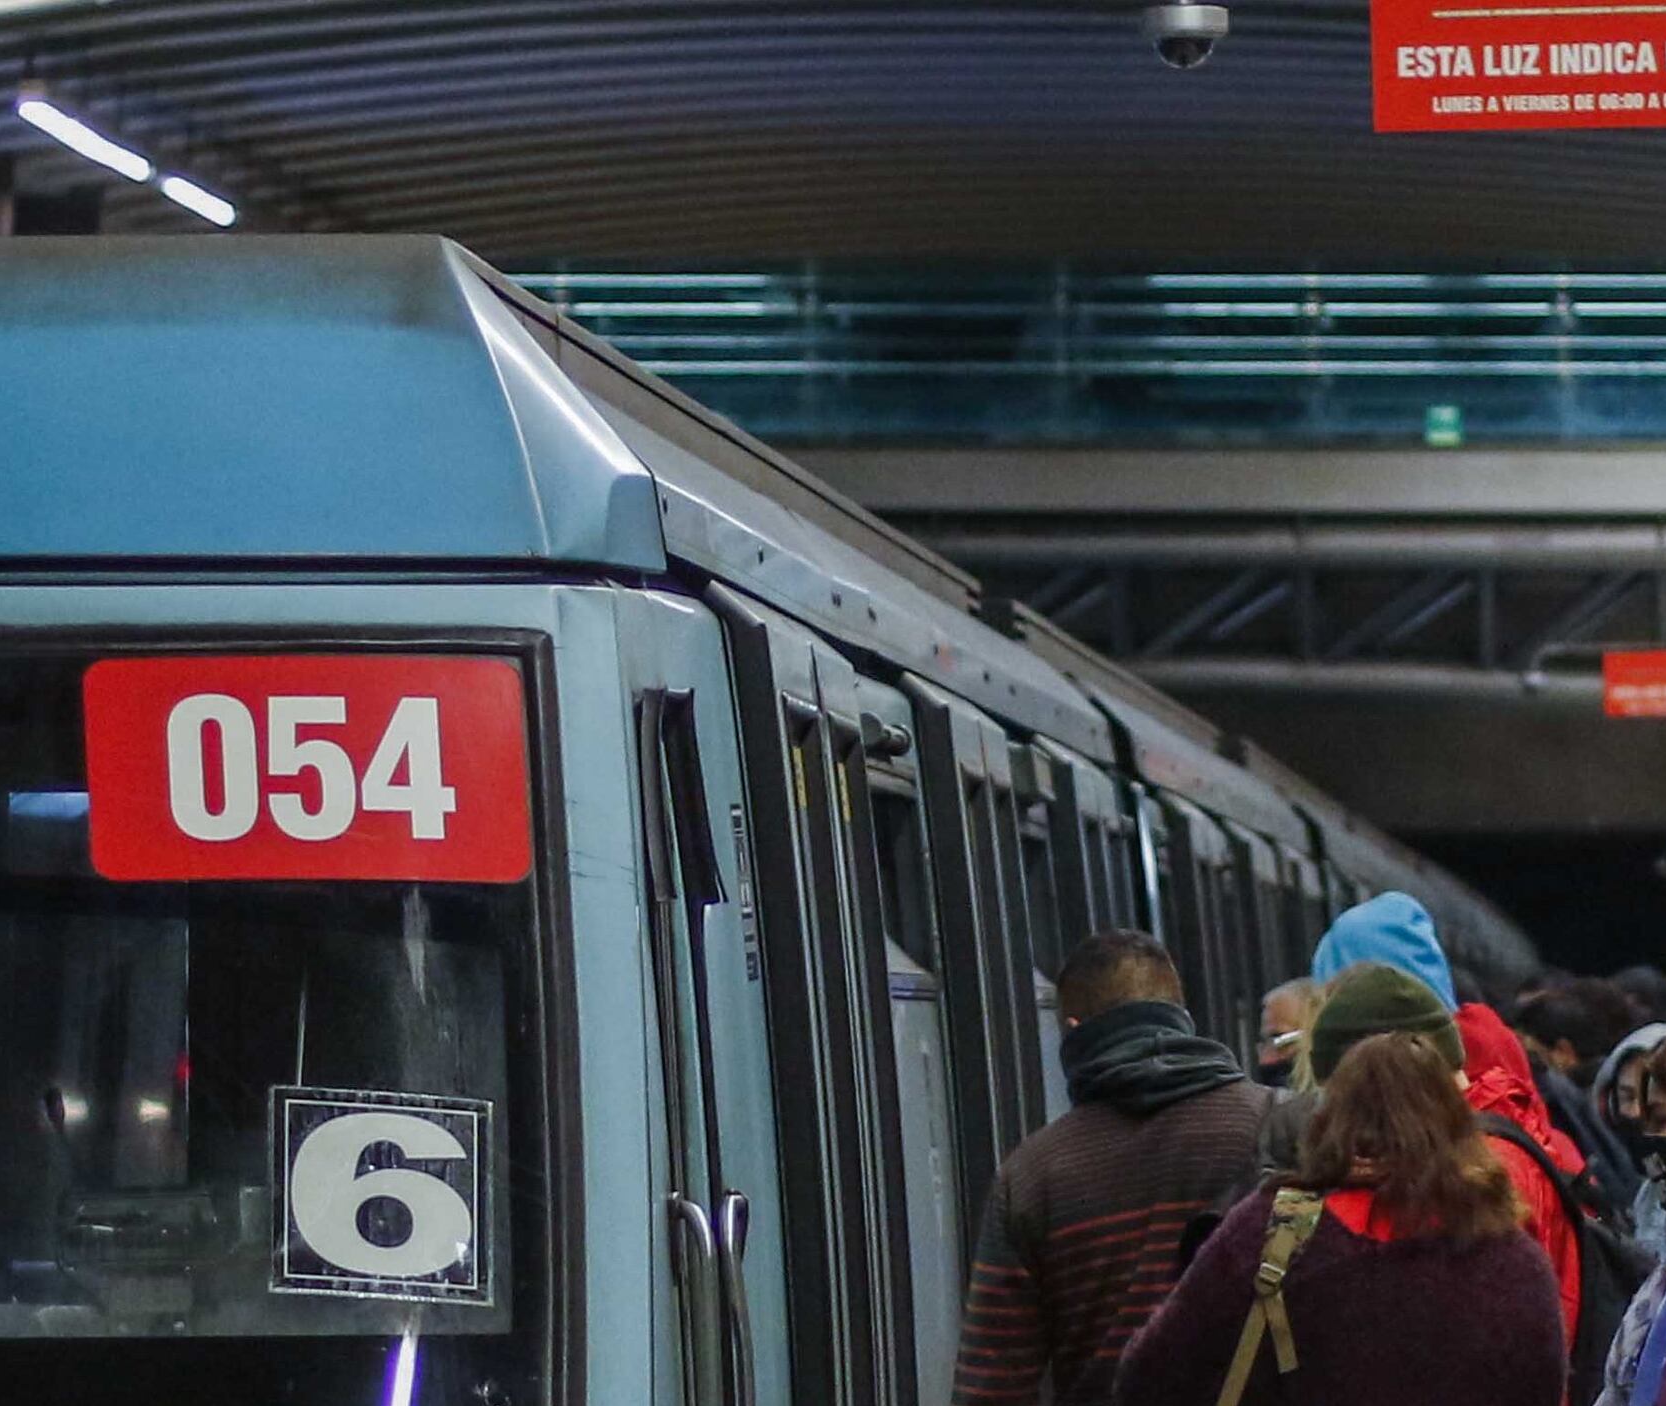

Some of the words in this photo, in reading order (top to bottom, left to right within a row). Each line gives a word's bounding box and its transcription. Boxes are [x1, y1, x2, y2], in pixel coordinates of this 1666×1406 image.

[1396, 45, 1475, 77] ESTA
[1483, 44, 1542, 76] LUZ
[1549, 41, 1658, 74] INDICA
[1433, 96, 1484, 113] LUNES
[1486, 96, 1500, 112] A
[1502, 94, 1570, 112] VIERNES
[1574, 94, 1595, 111] DE
[1647, 92, 1661, 109] A
[165, 692, 457, 841] 054
[290, 1111, 474, 1277] 6
